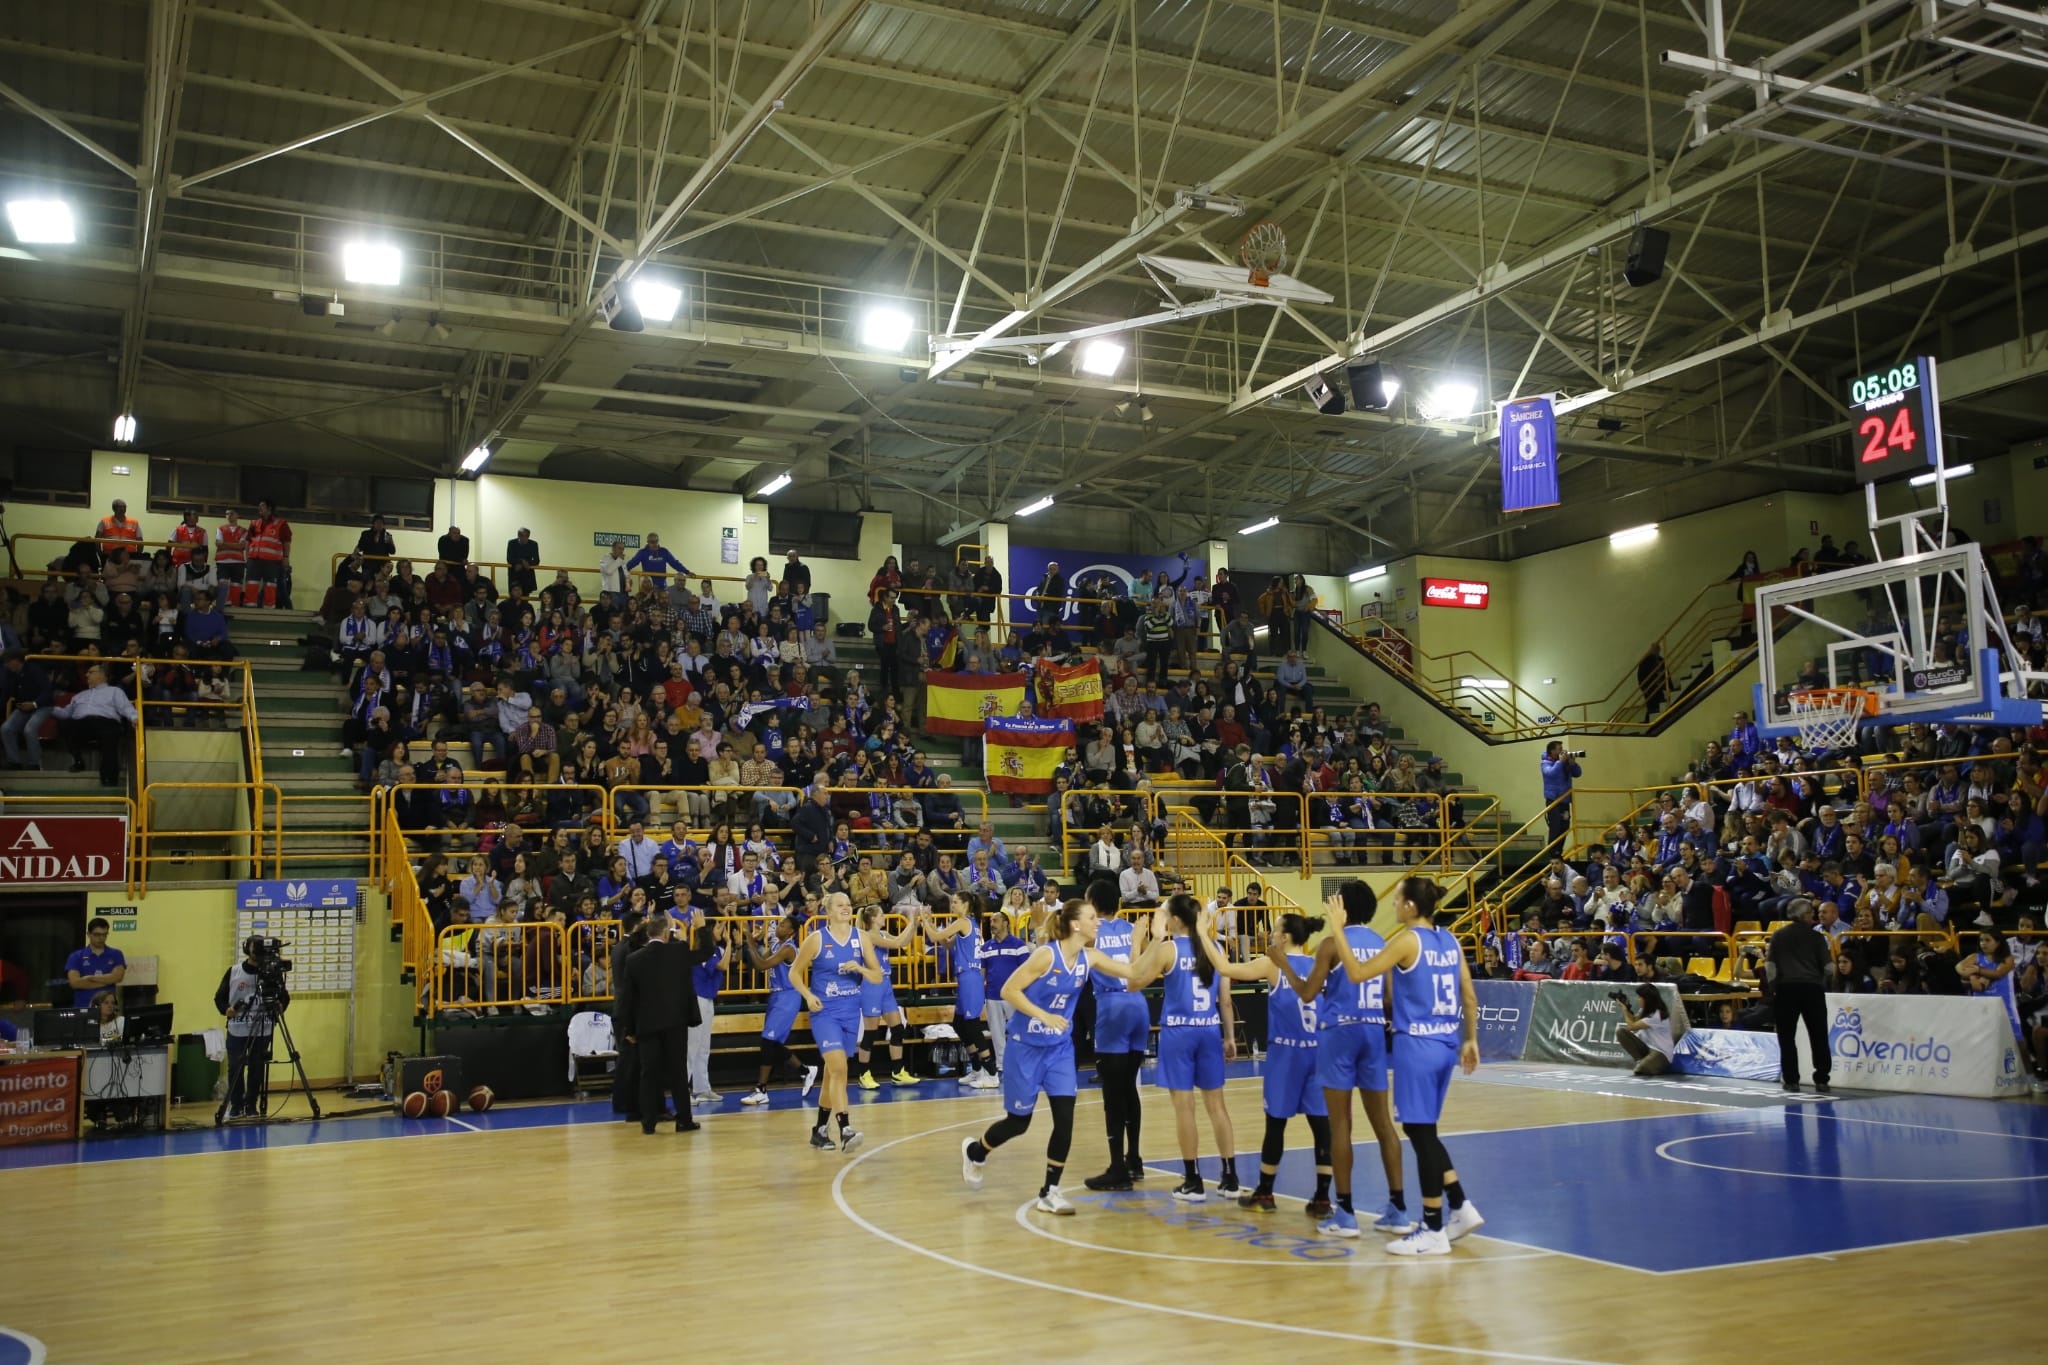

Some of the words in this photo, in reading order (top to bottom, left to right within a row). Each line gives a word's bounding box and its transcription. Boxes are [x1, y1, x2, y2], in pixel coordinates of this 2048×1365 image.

[1852, 363, 1917, 404] 05:08
[1519, 422, 1538, 461] 8
[1860, 407, 1917, 463] 24
[8, 820, 54, 850] A
[0, 855, 111, 879] NIDAD
[110, 907, 135, 915] SALIDA
[1049, 993, 1070, 1009] 15
[1191, 976, 1211, 1011] 5
[1358, 974, 1383, 1009] 12
[1432, 973, 1457, 1015] 13
[1297, 998, 1317, 1033] 6
[1582, 1000, 1617, 1014] ANNE
[1549, 1014, 1629, 1045] MÖLLE
[0, 1071, 69, 1092] miento
[1831, 1060, 1950, 1078] ERFUMERÍAS
[0, 1097, 66, 1116] manca
[8, 1122, 69, 1137] Deportes
